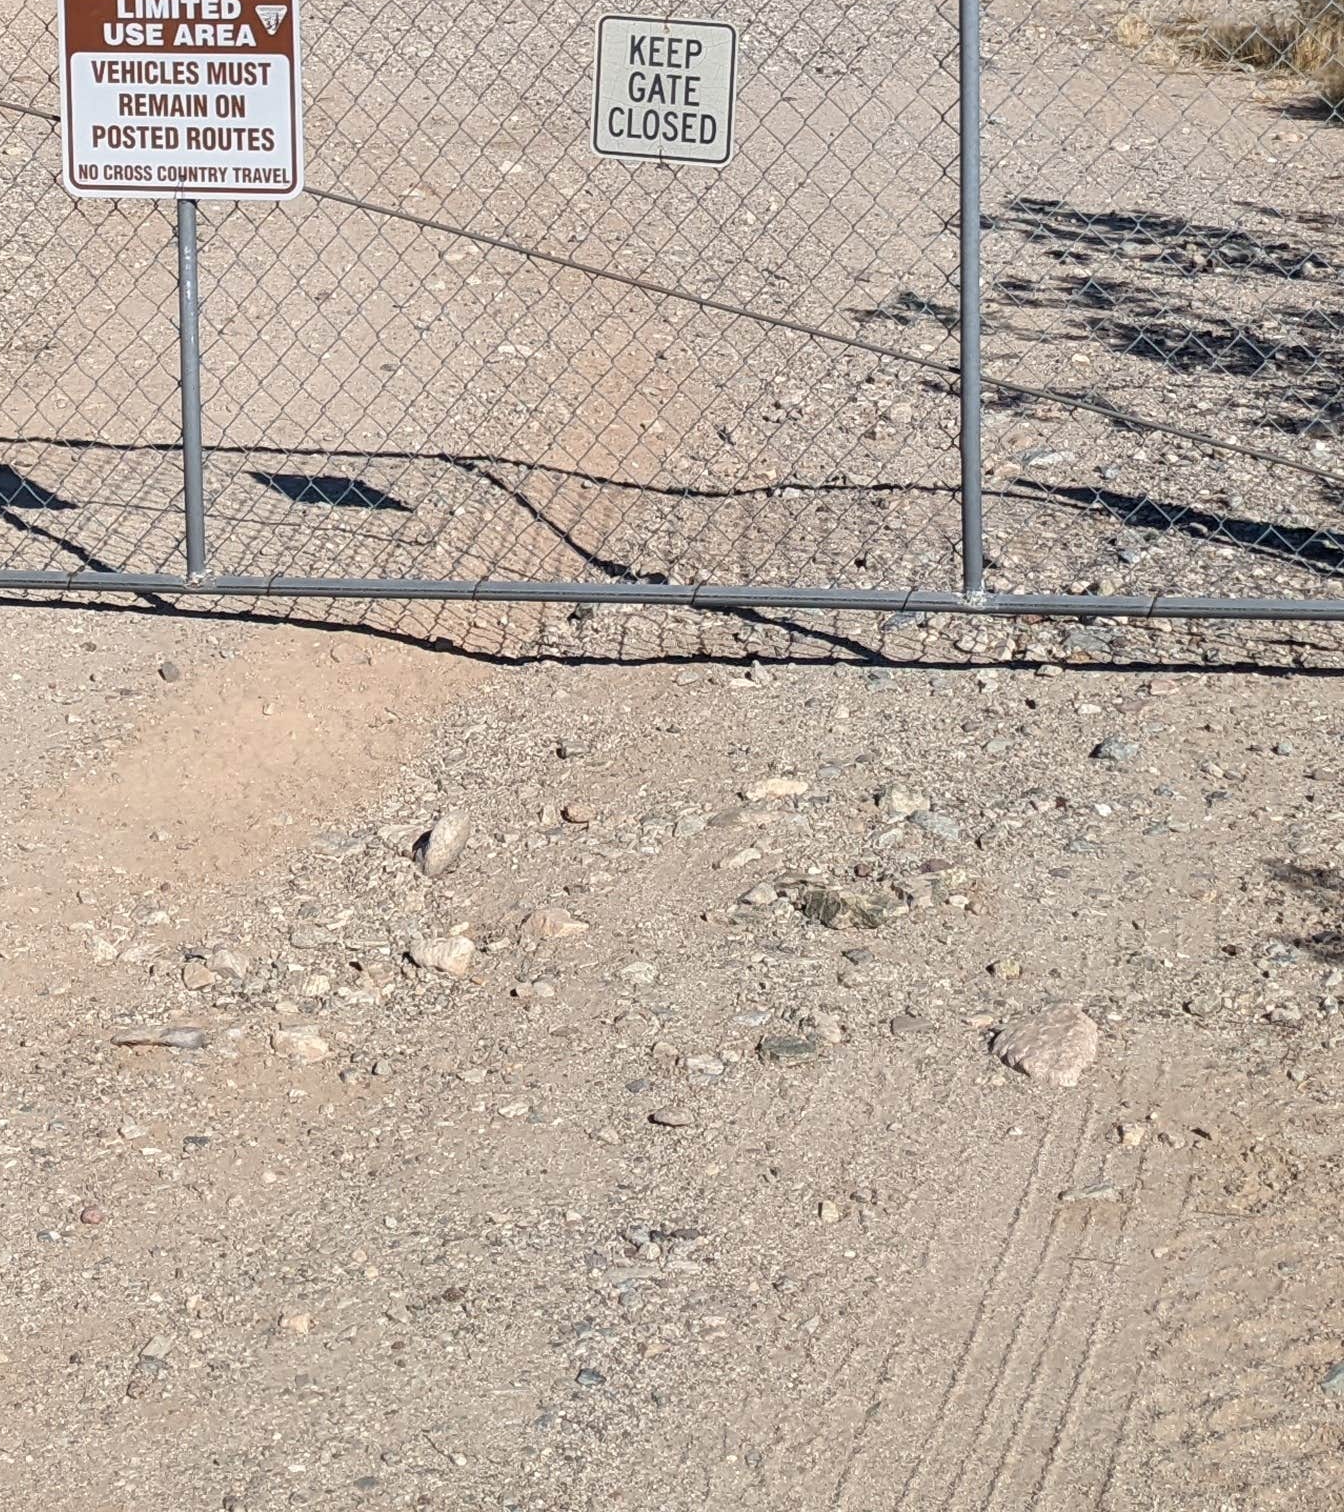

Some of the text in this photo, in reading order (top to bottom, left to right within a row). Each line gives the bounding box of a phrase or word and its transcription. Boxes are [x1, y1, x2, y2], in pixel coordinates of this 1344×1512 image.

[103, 23, 256, 47] USE AREA
[629, 35, 702, 69] KEEP
[91, 60, 271, 86] VEHICLES MUST
[628, 71, 701, 106] GATE
[119, 94, 246, 118] REMAIN ON
[608, 106, 717, 144] CLOSED
[92, 126, 275, 151] POSTED ROUTES
[78, 164, 290, 184] NO CROSS COUNTRY TRAVEL
